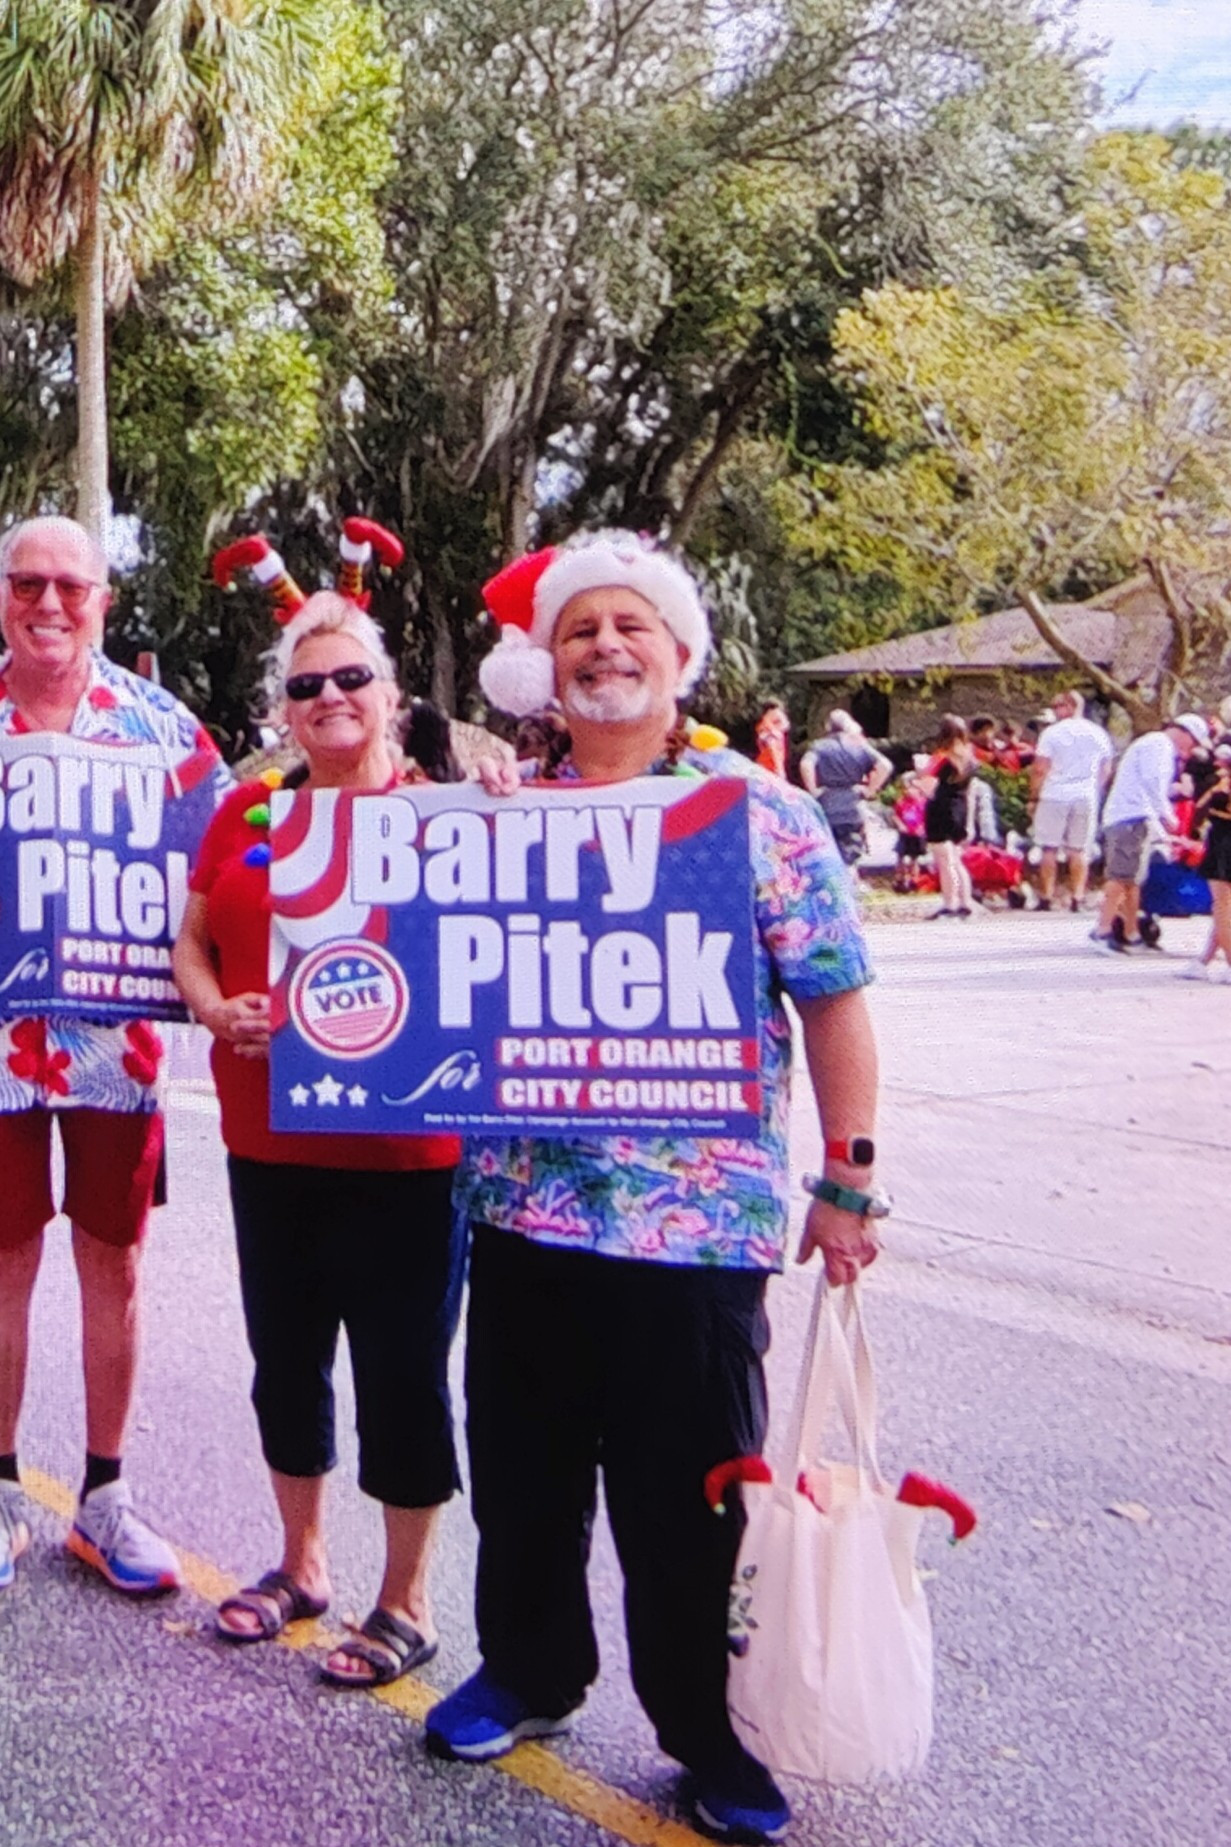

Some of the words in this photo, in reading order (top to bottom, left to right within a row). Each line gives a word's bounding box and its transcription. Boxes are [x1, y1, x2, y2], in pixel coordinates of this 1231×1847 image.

[351, 795, 662, 912] Barry
[61, 938, 121, 964] PORT
[127, 944, 172, 968] ORA
[61, 970, 117, 994] CITY
[438, 912, 740, 1029] Pitek
[315, 984, 383, 1013] VOTE
[500, 1040, 591, 1067] PORT
[599, 1040, 742, 1069] ORANGE
[382, 1049, 481, 1105] for
[501, 1079, 588, 1107] CITY
[589, 1081, 749, 1111] COUNCIL
